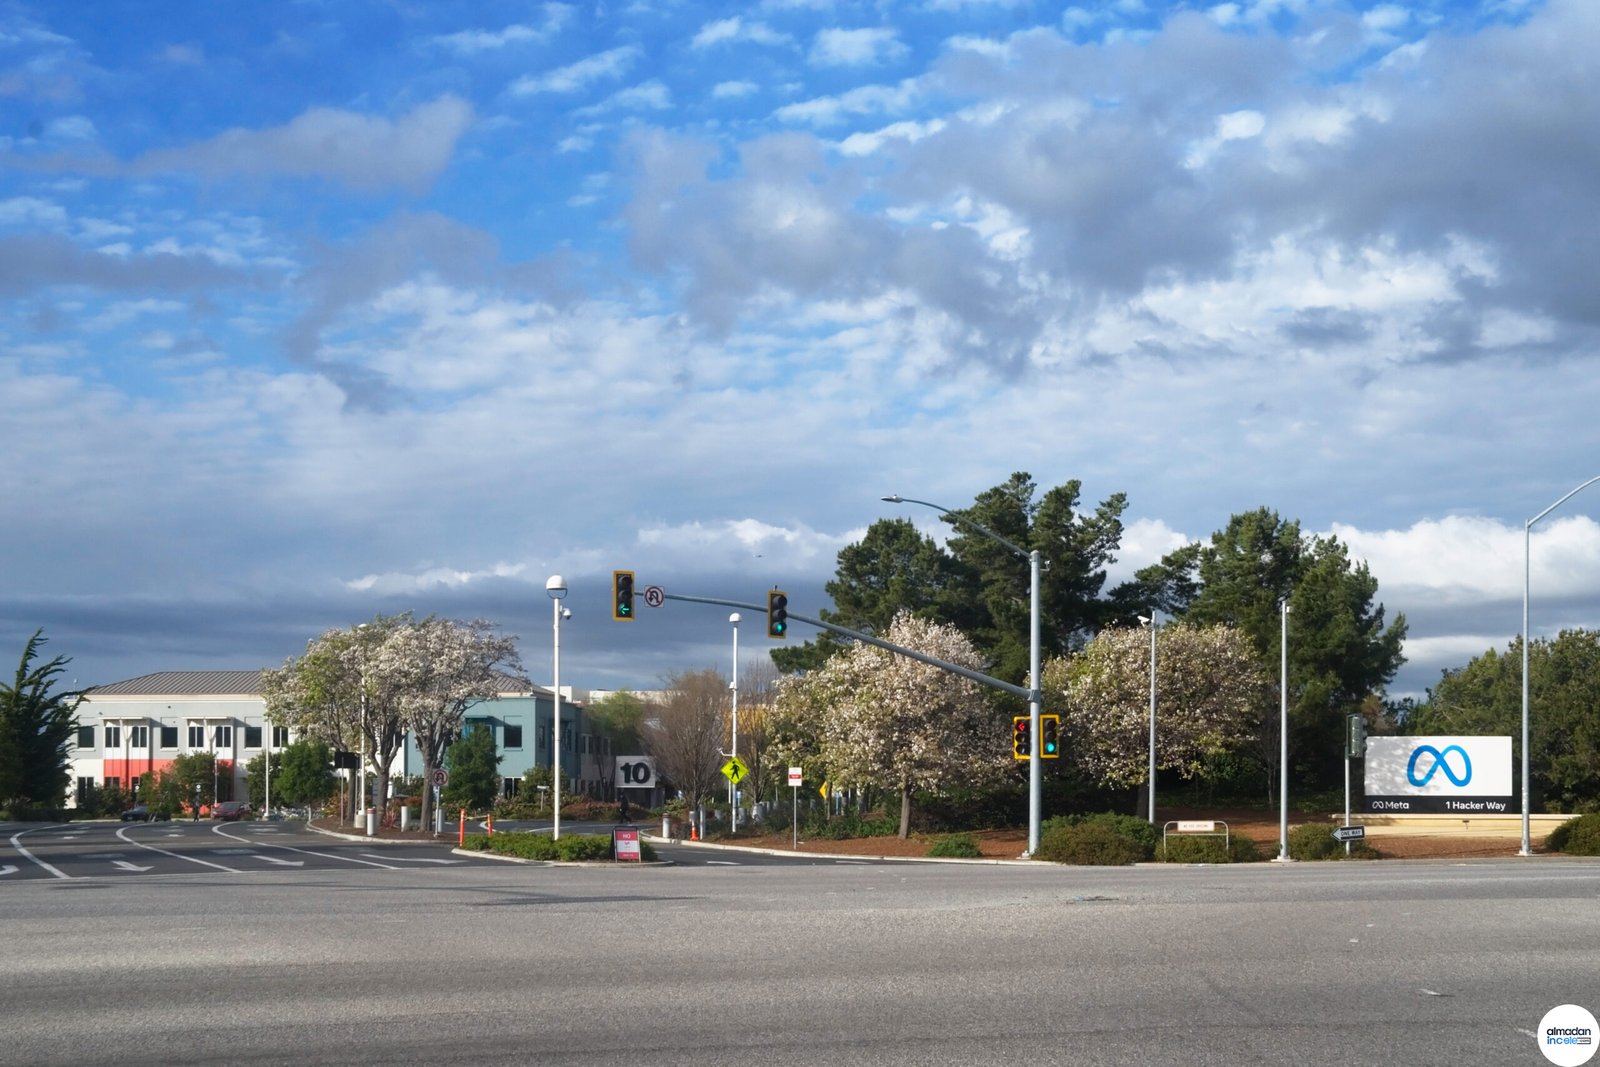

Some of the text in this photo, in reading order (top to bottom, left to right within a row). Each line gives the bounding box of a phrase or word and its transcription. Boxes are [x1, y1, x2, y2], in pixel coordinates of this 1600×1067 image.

[620, 762, 651, 784] 10
[1385, 801, 1410, 809] Meta
[1445, 801, 1506, 811] 1 Hacker Way
